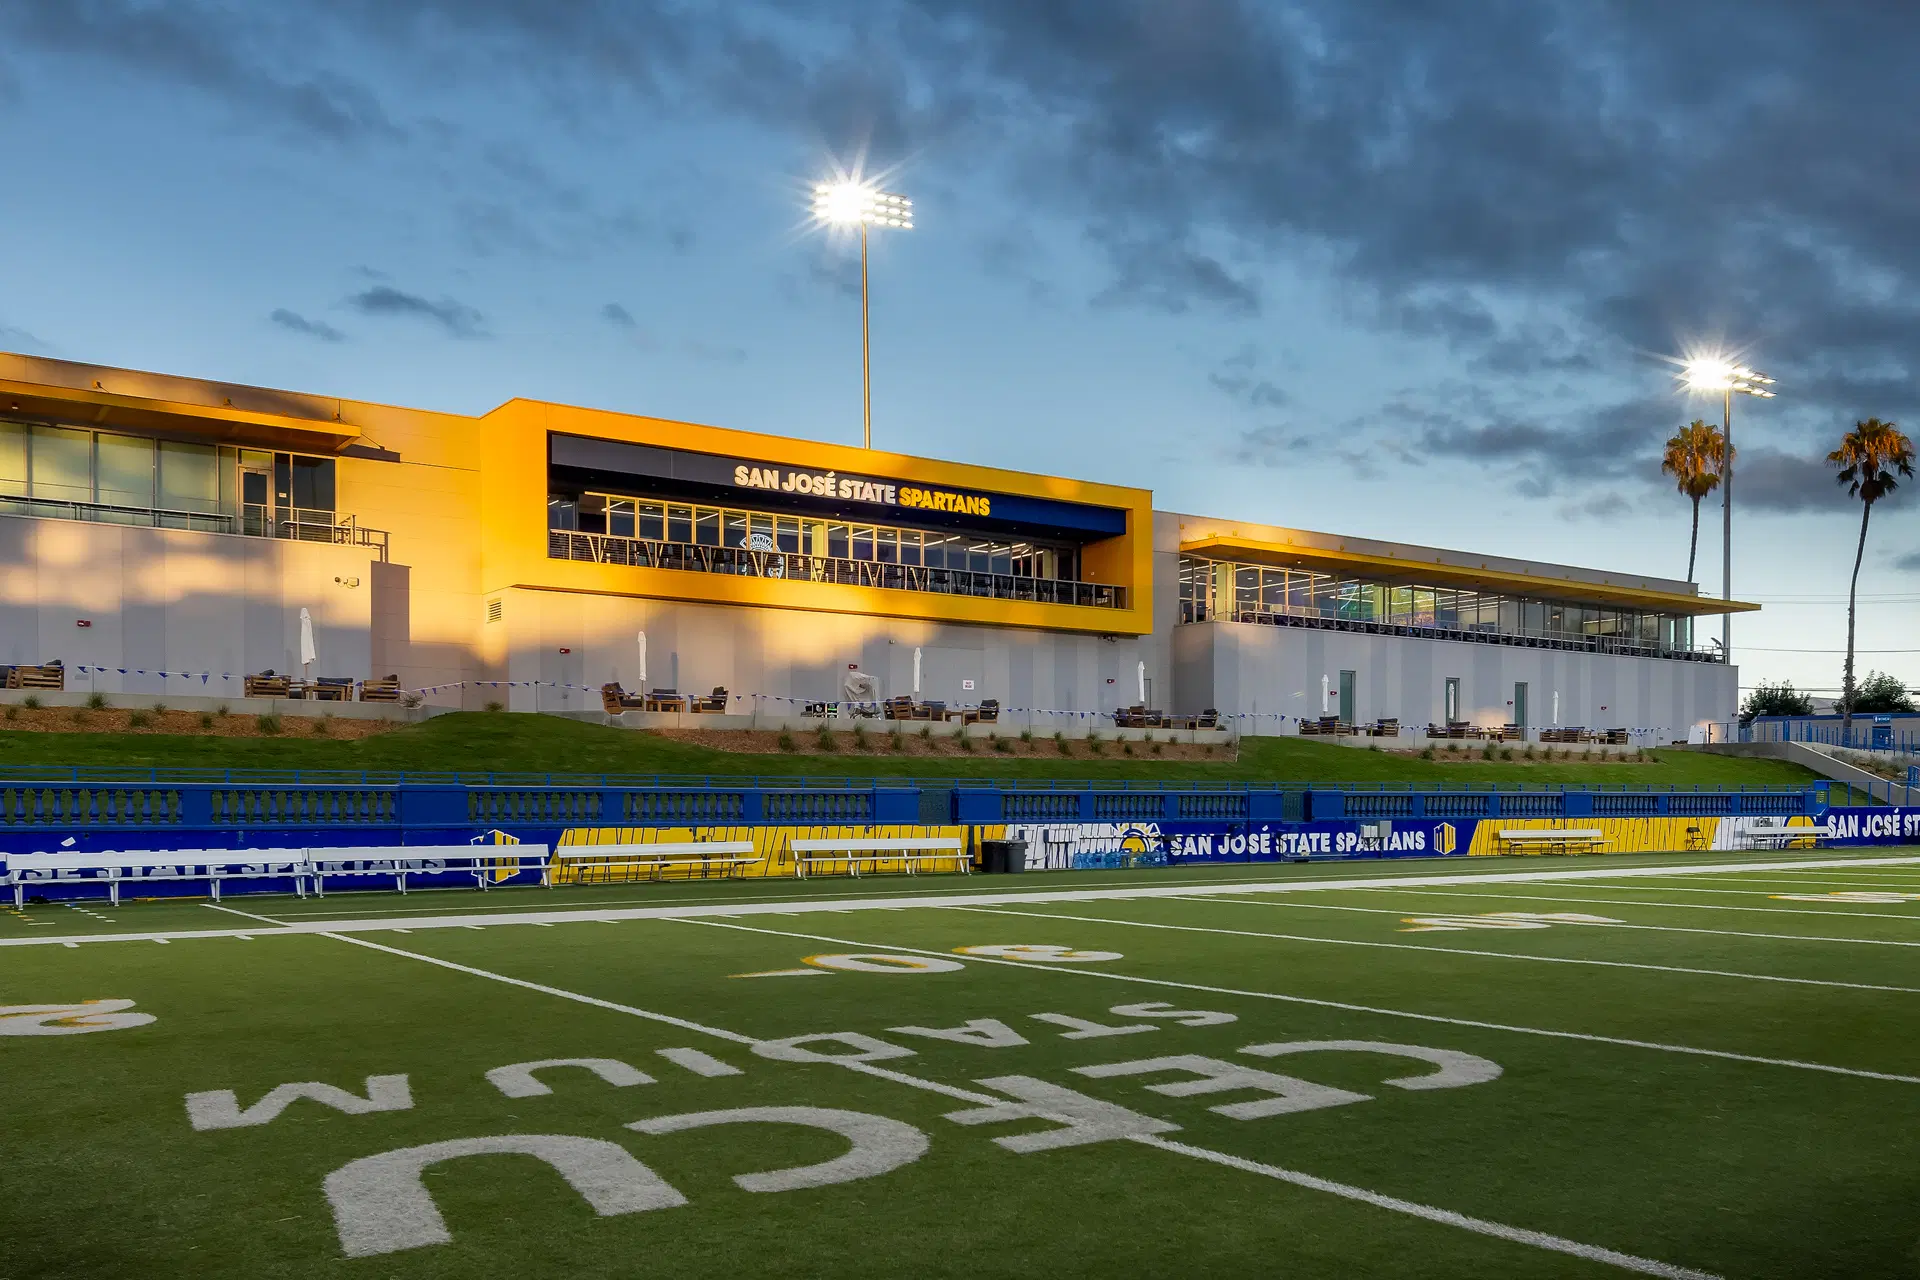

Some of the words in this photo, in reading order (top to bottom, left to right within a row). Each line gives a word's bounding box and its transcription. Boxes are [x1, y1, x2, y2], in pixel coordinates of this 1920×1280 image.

[734, 465, 780, 490] SAN
[781, 470, 837, 495] JOSÉ
[838, 478, 897, 506] STATE
[898, 487, 990, 517] SPARTANS
[1170, 834, 1212, 856] SAN
[1217, 825, 1271, 855] JOSÉ
[1276, 833, 1331, 854] STATE
[1335, 831, 1426, 852] SPARTANS
[1826, 814, 1859, 838] SAN
[1862, 807, 1901, 838] JOSÉ
[1904, 814, 1920, 838] ST
[185, 1001, 1238, 1132] STADIUM
[323, 1039, 1502, 1258] CEFCU
